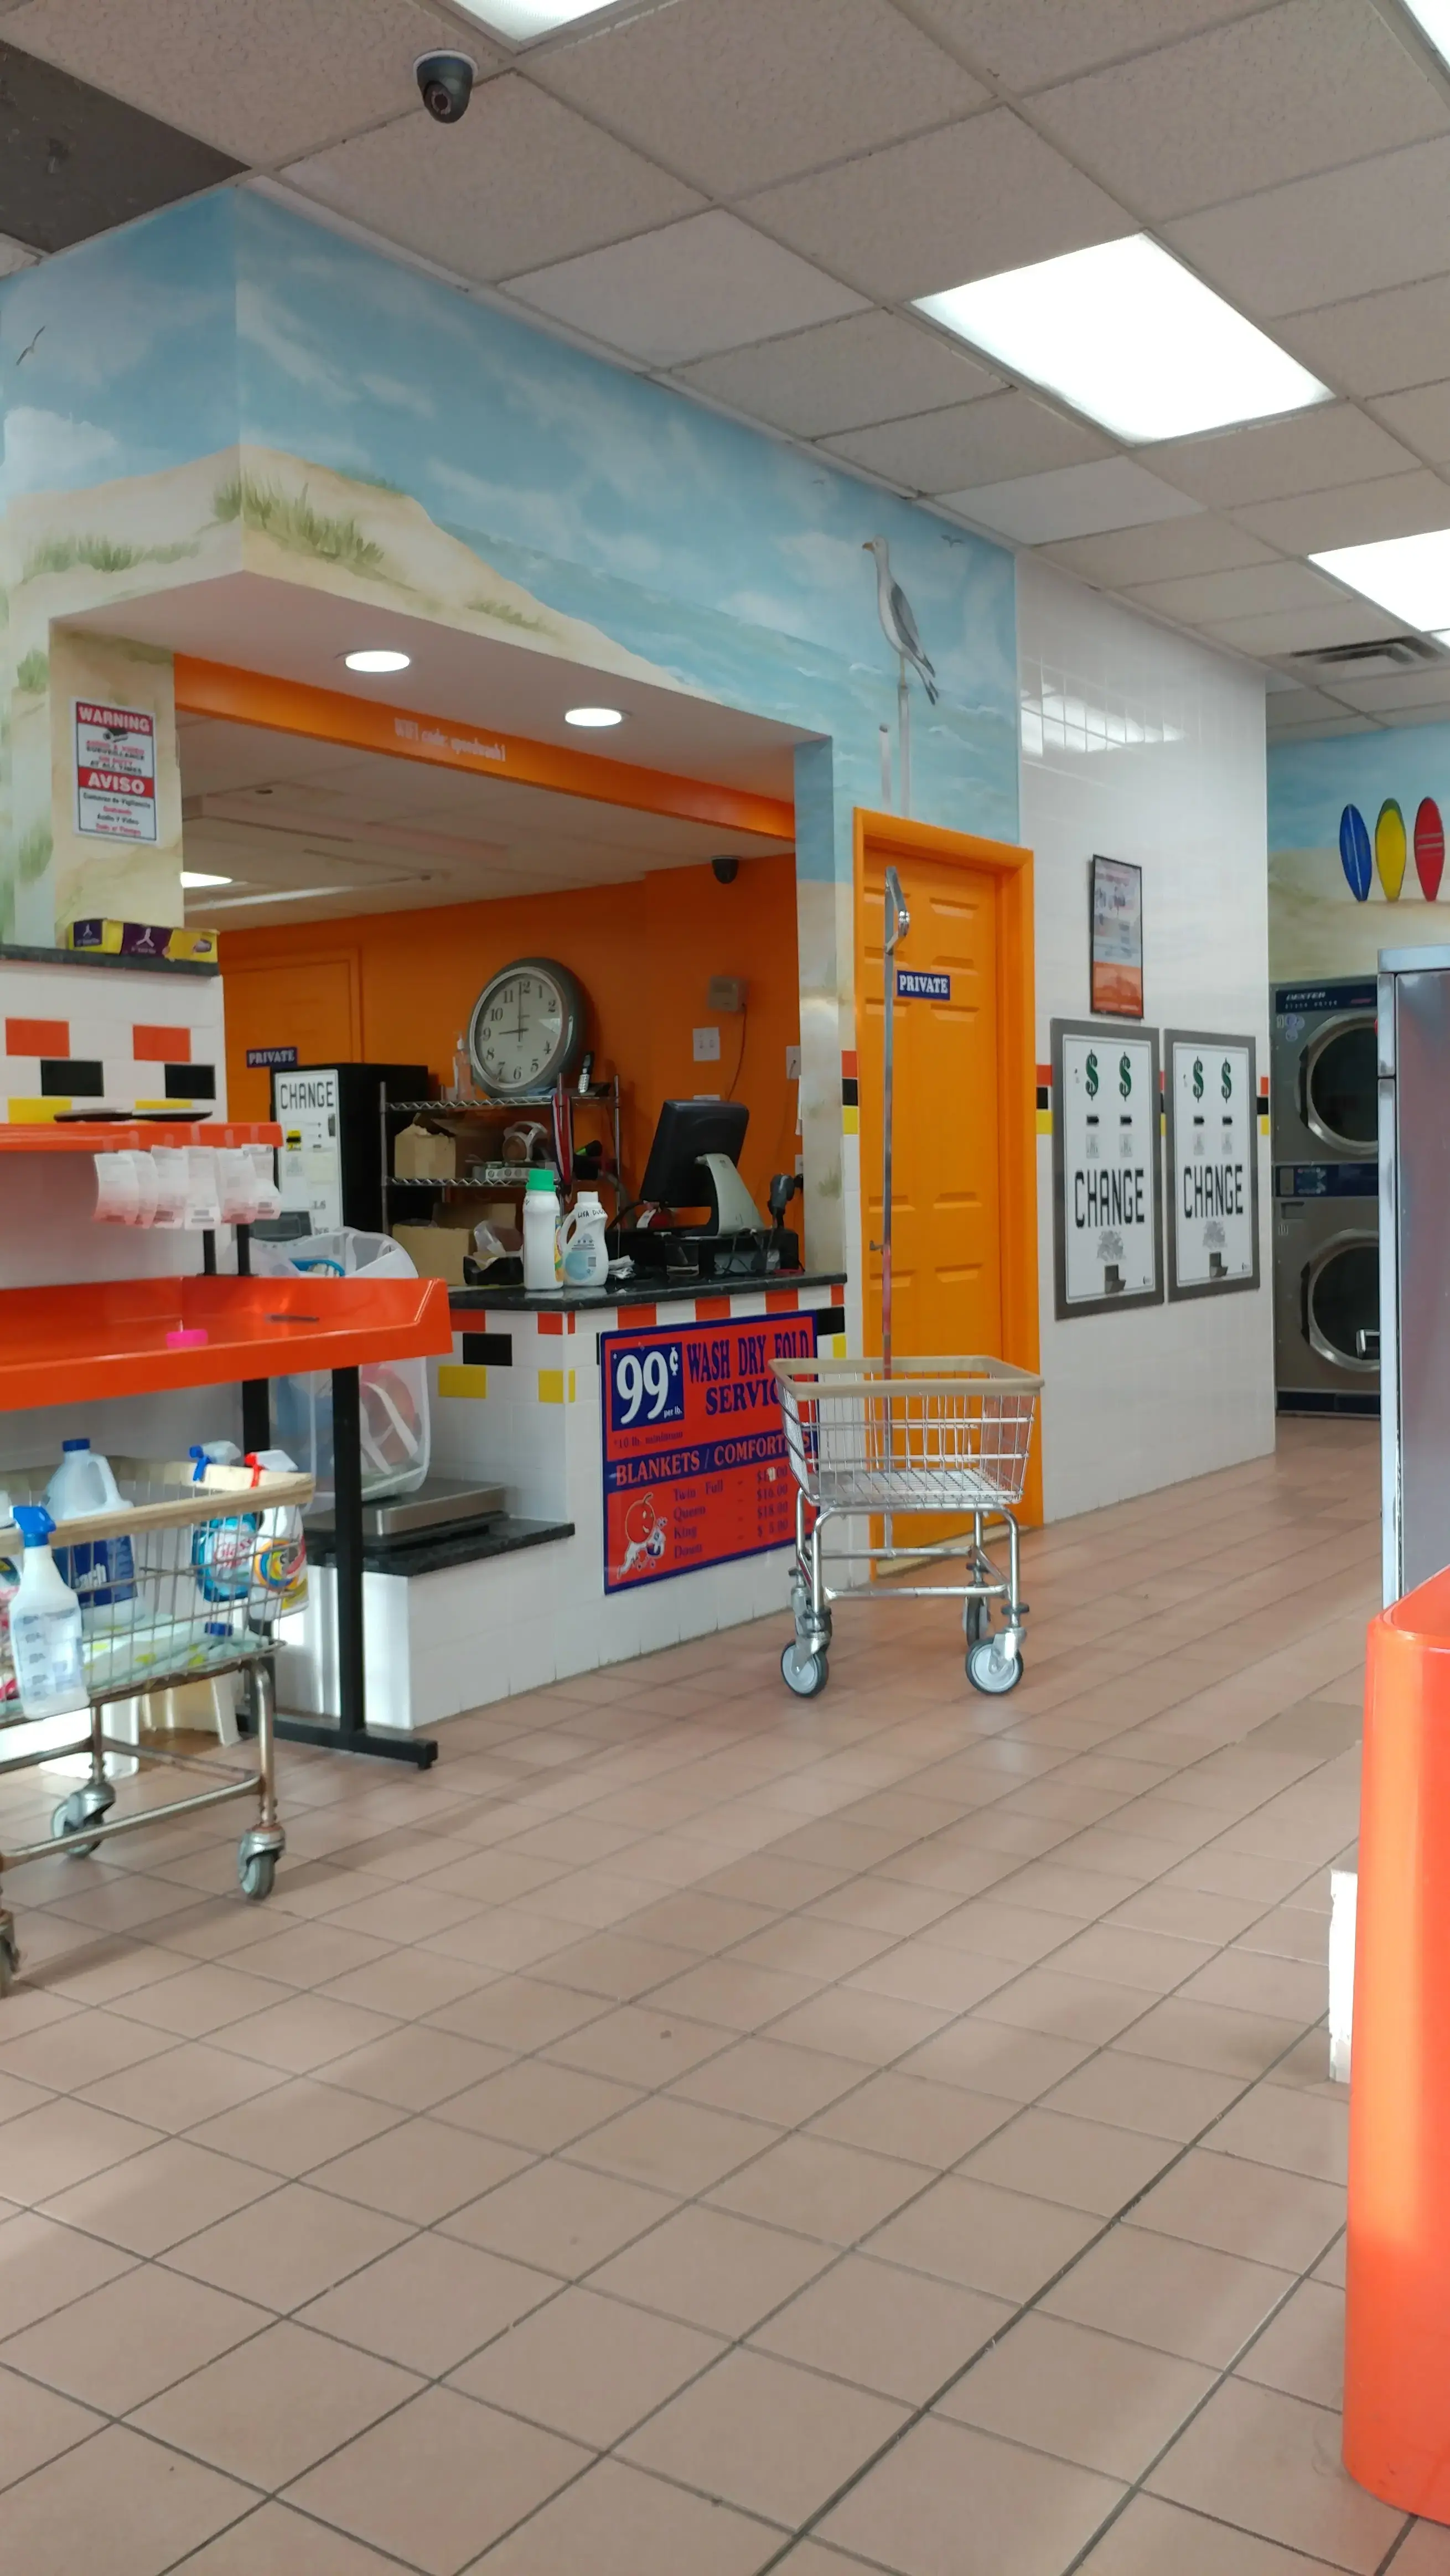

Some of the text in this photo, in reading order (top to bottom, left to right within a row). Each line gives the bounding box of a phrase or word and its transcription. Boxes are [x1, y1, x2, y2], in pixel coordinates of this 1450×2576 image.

[79, 706, 149, 732] WARNING
[89, 772, 144, 794] AVISO
[518, 981, 530, 994] 12
[538, 985, 542, 998] 1
[899, 974, 948, 994] PRIVATE
[504, 990, 514, 1003] 11
[548, 999, 556, 1013] 2
[490, 1007, 503, 1022] 10
[483, 1027, 491, 1041] 9
[486, 1047, 494, 1061] 8
[543, 1041, 551, 1055] 4
[248, 1050, 295, 1065] PRIVATE
[498, 1062, 505, 1076] 7
[514, 1066, 521, 1079] 6
[531, 1059, 539, 1072] 5
[280, 1081, 334, 1110] CHANGE
[1075, 1168, 1145, 1229] CHANGE
[1184, 1164, 1243, 1218] CHANGE
[686, 1330, 809, 1384] WASH DRY FOLD
[706, 1378, 779, 1415] SERVIC
[664, 1406, 682, 1419] per lb.
[616, 1450, 700, 1487] BLANKETS
[714, 1430, 810, 1466] COMFORTS
[674, 1488, 697, 1502] Twin
[705, 1479, 723, 1495] Full
[674, 1506, 706, 1523] Queen
[674, 1526, 697, 1540] King
[675, 1544, 702, 1559] Down
